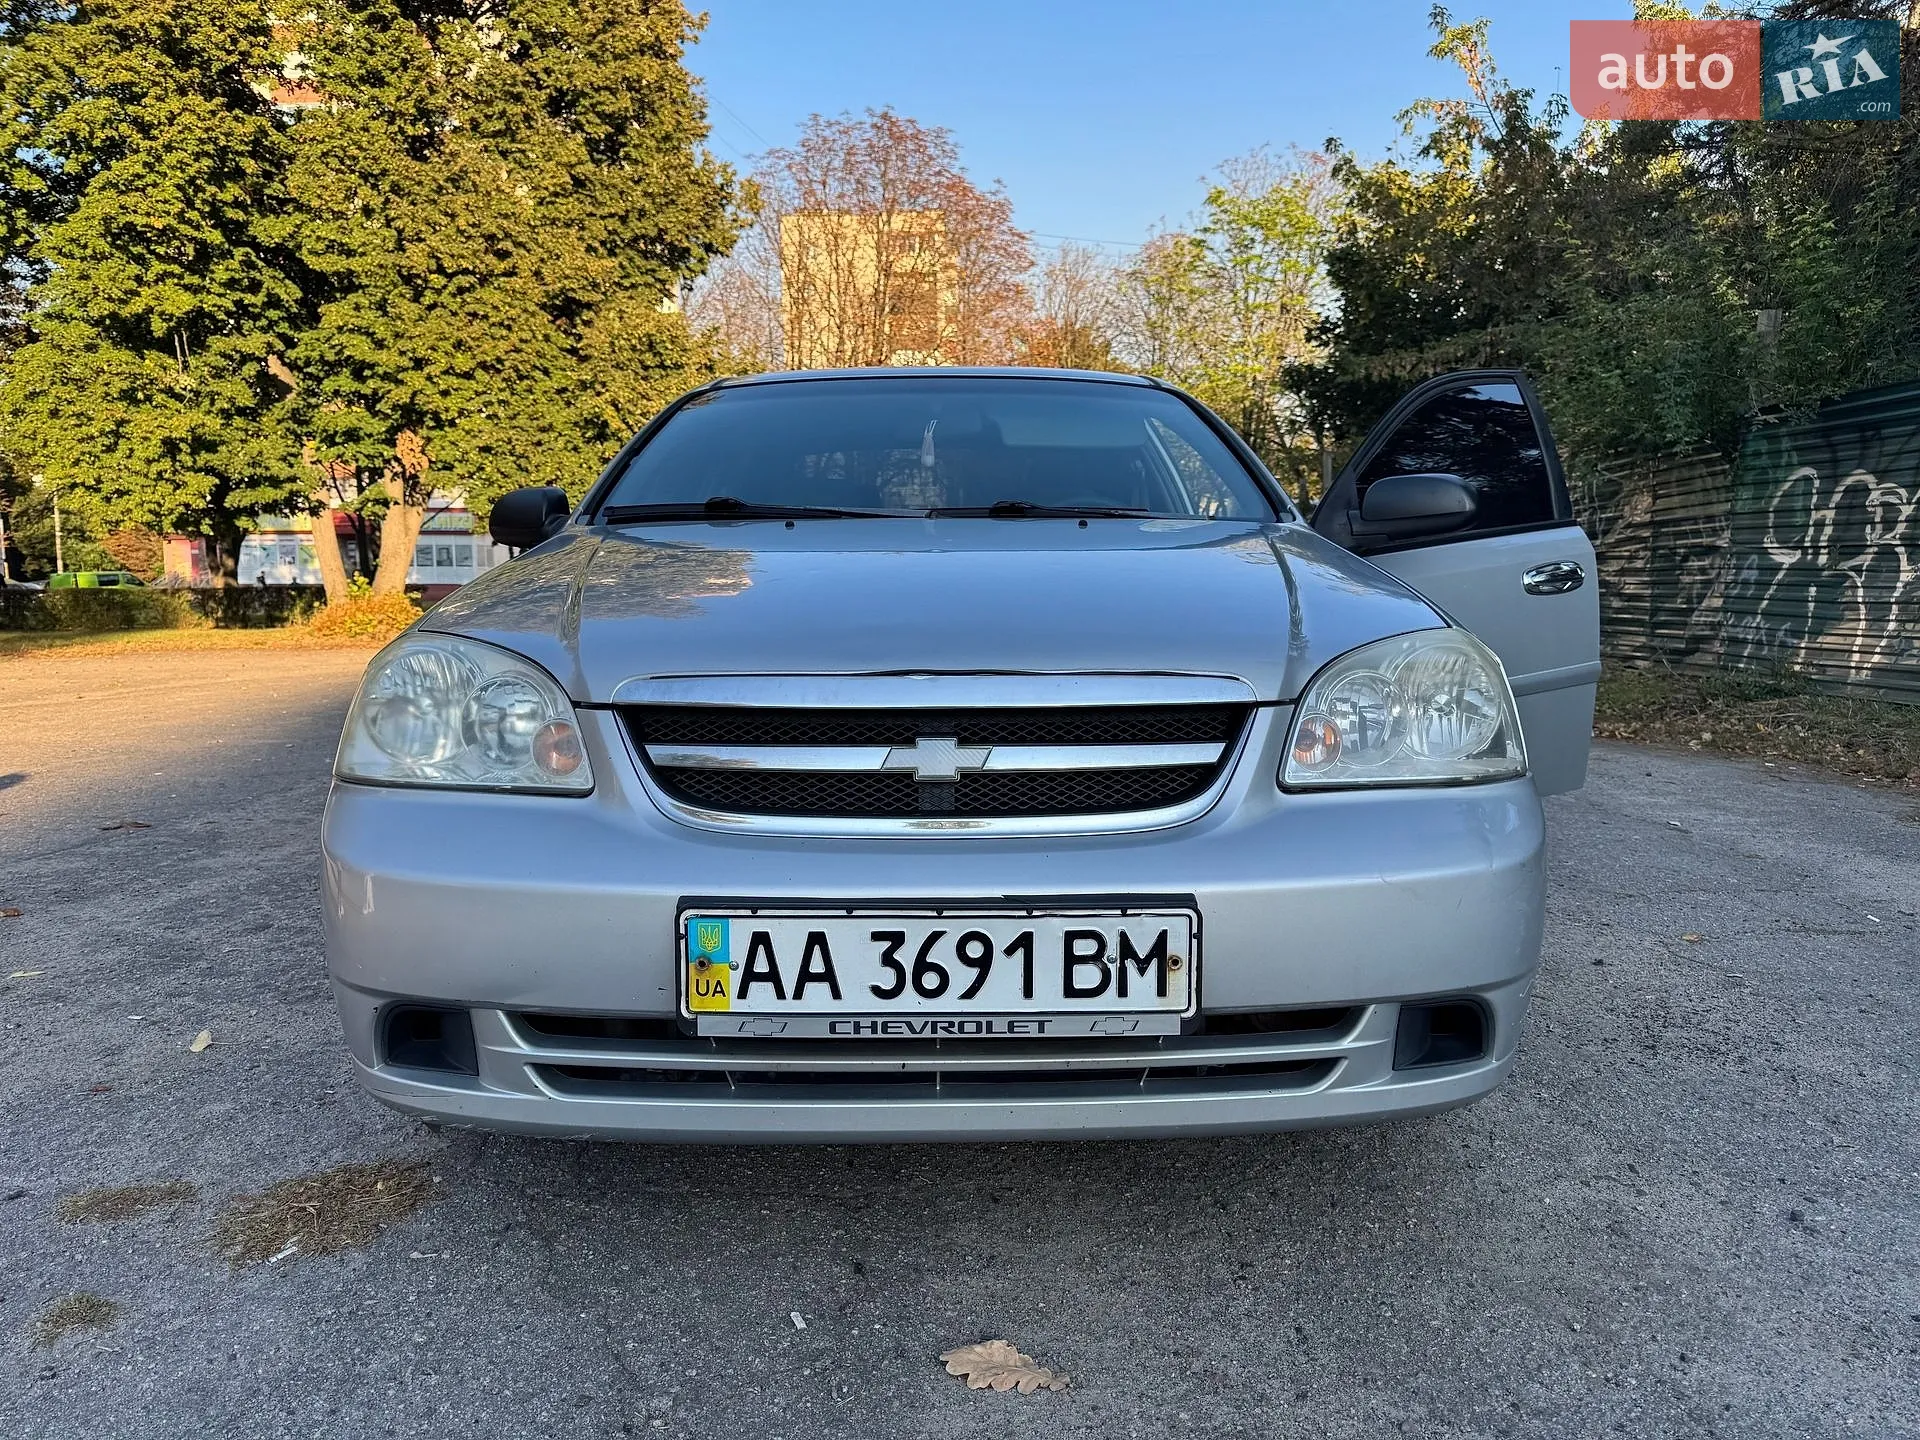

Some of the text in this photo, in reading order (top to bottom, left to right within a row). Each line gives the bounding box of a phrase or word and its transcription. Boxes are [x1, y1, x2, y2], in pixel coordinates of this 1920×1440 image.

[737, 928, 1169, 1000] AA 3691 BM
[695, 979, 727, 998] UA
[828, 1019, 1053, 1035] CHEVROLET
